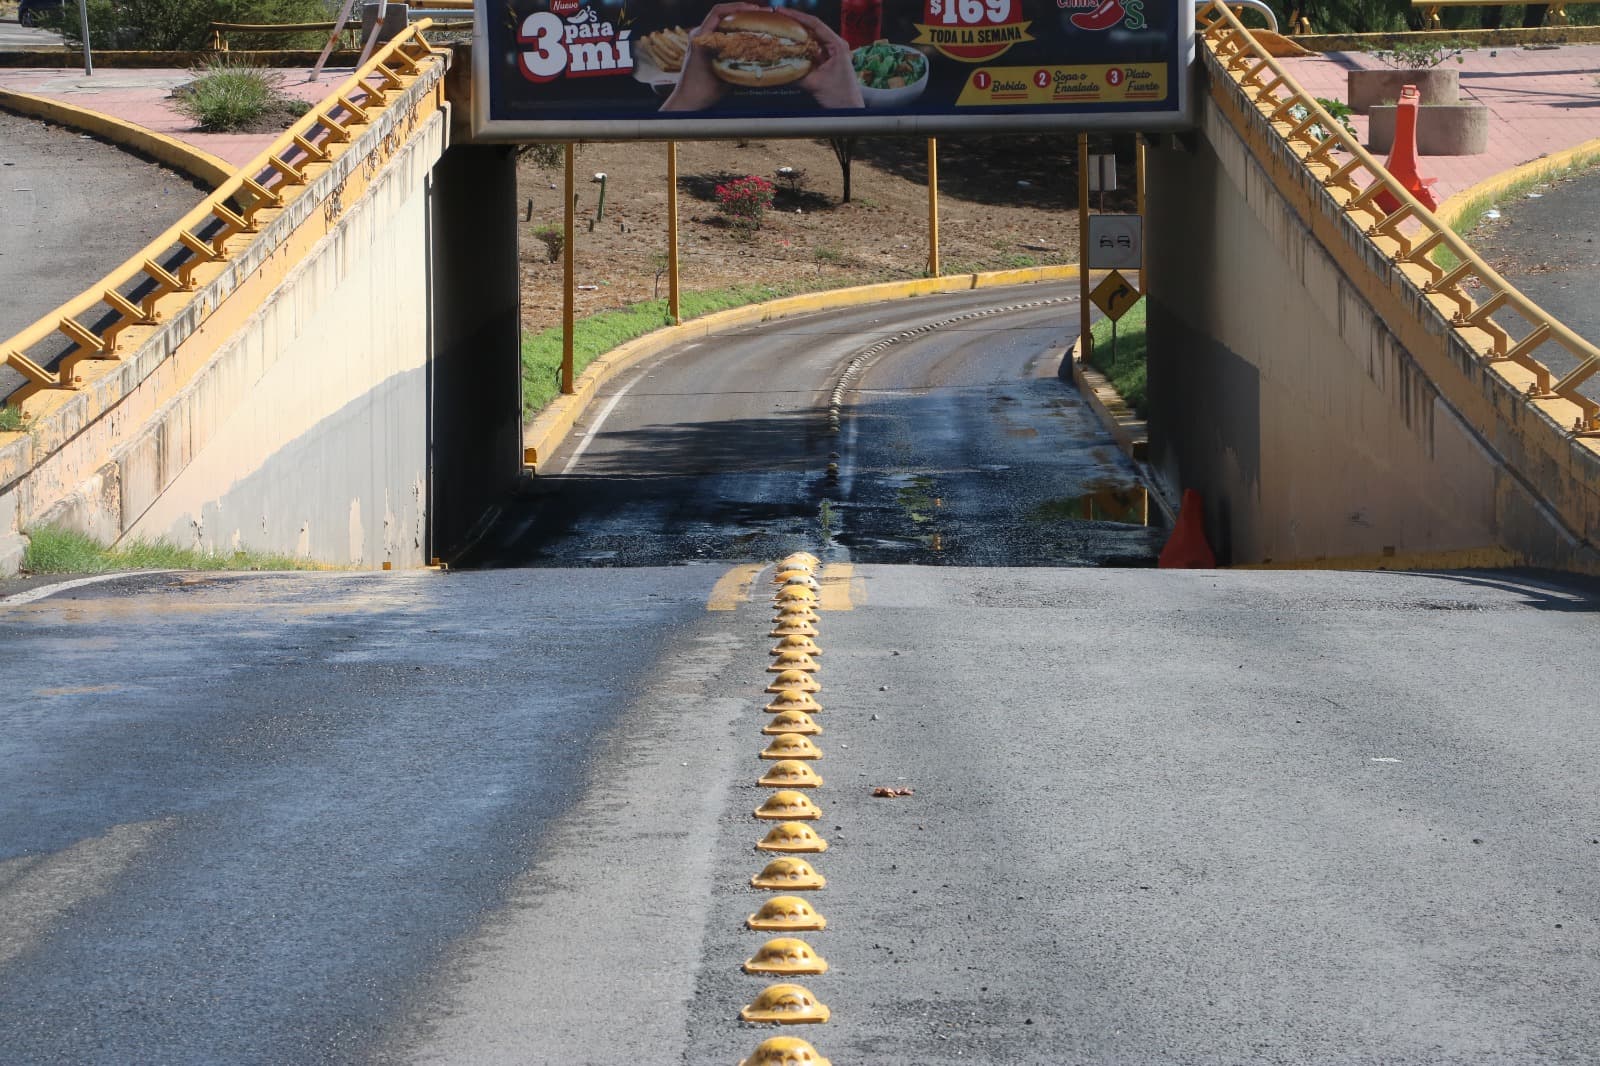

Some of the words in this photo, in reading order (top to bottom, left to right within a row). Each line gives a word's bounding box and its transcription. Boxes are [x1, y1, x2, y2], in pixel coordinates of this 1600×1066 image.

[553, 0, 578, 11] Nuevo
[564, 21, 614, 44] para
[929, 29, 958, 43] TODA
[961, 31, 974, 43] LA
[977, 26, 1022, 43] SEMANA
[522, 11, 567, 76] 3
[569, 29, 634, 72] mí
[1039, 72, 1047, 86] 2
[1053, 70, 1079, 83] Sopa
[1111, 70, 1119, 84] 3
[1125, 68, 1152, 80] Plato
[991, 80, 1028, 92] Bebida
[1127, 80, 1160, 91] Fuerte
